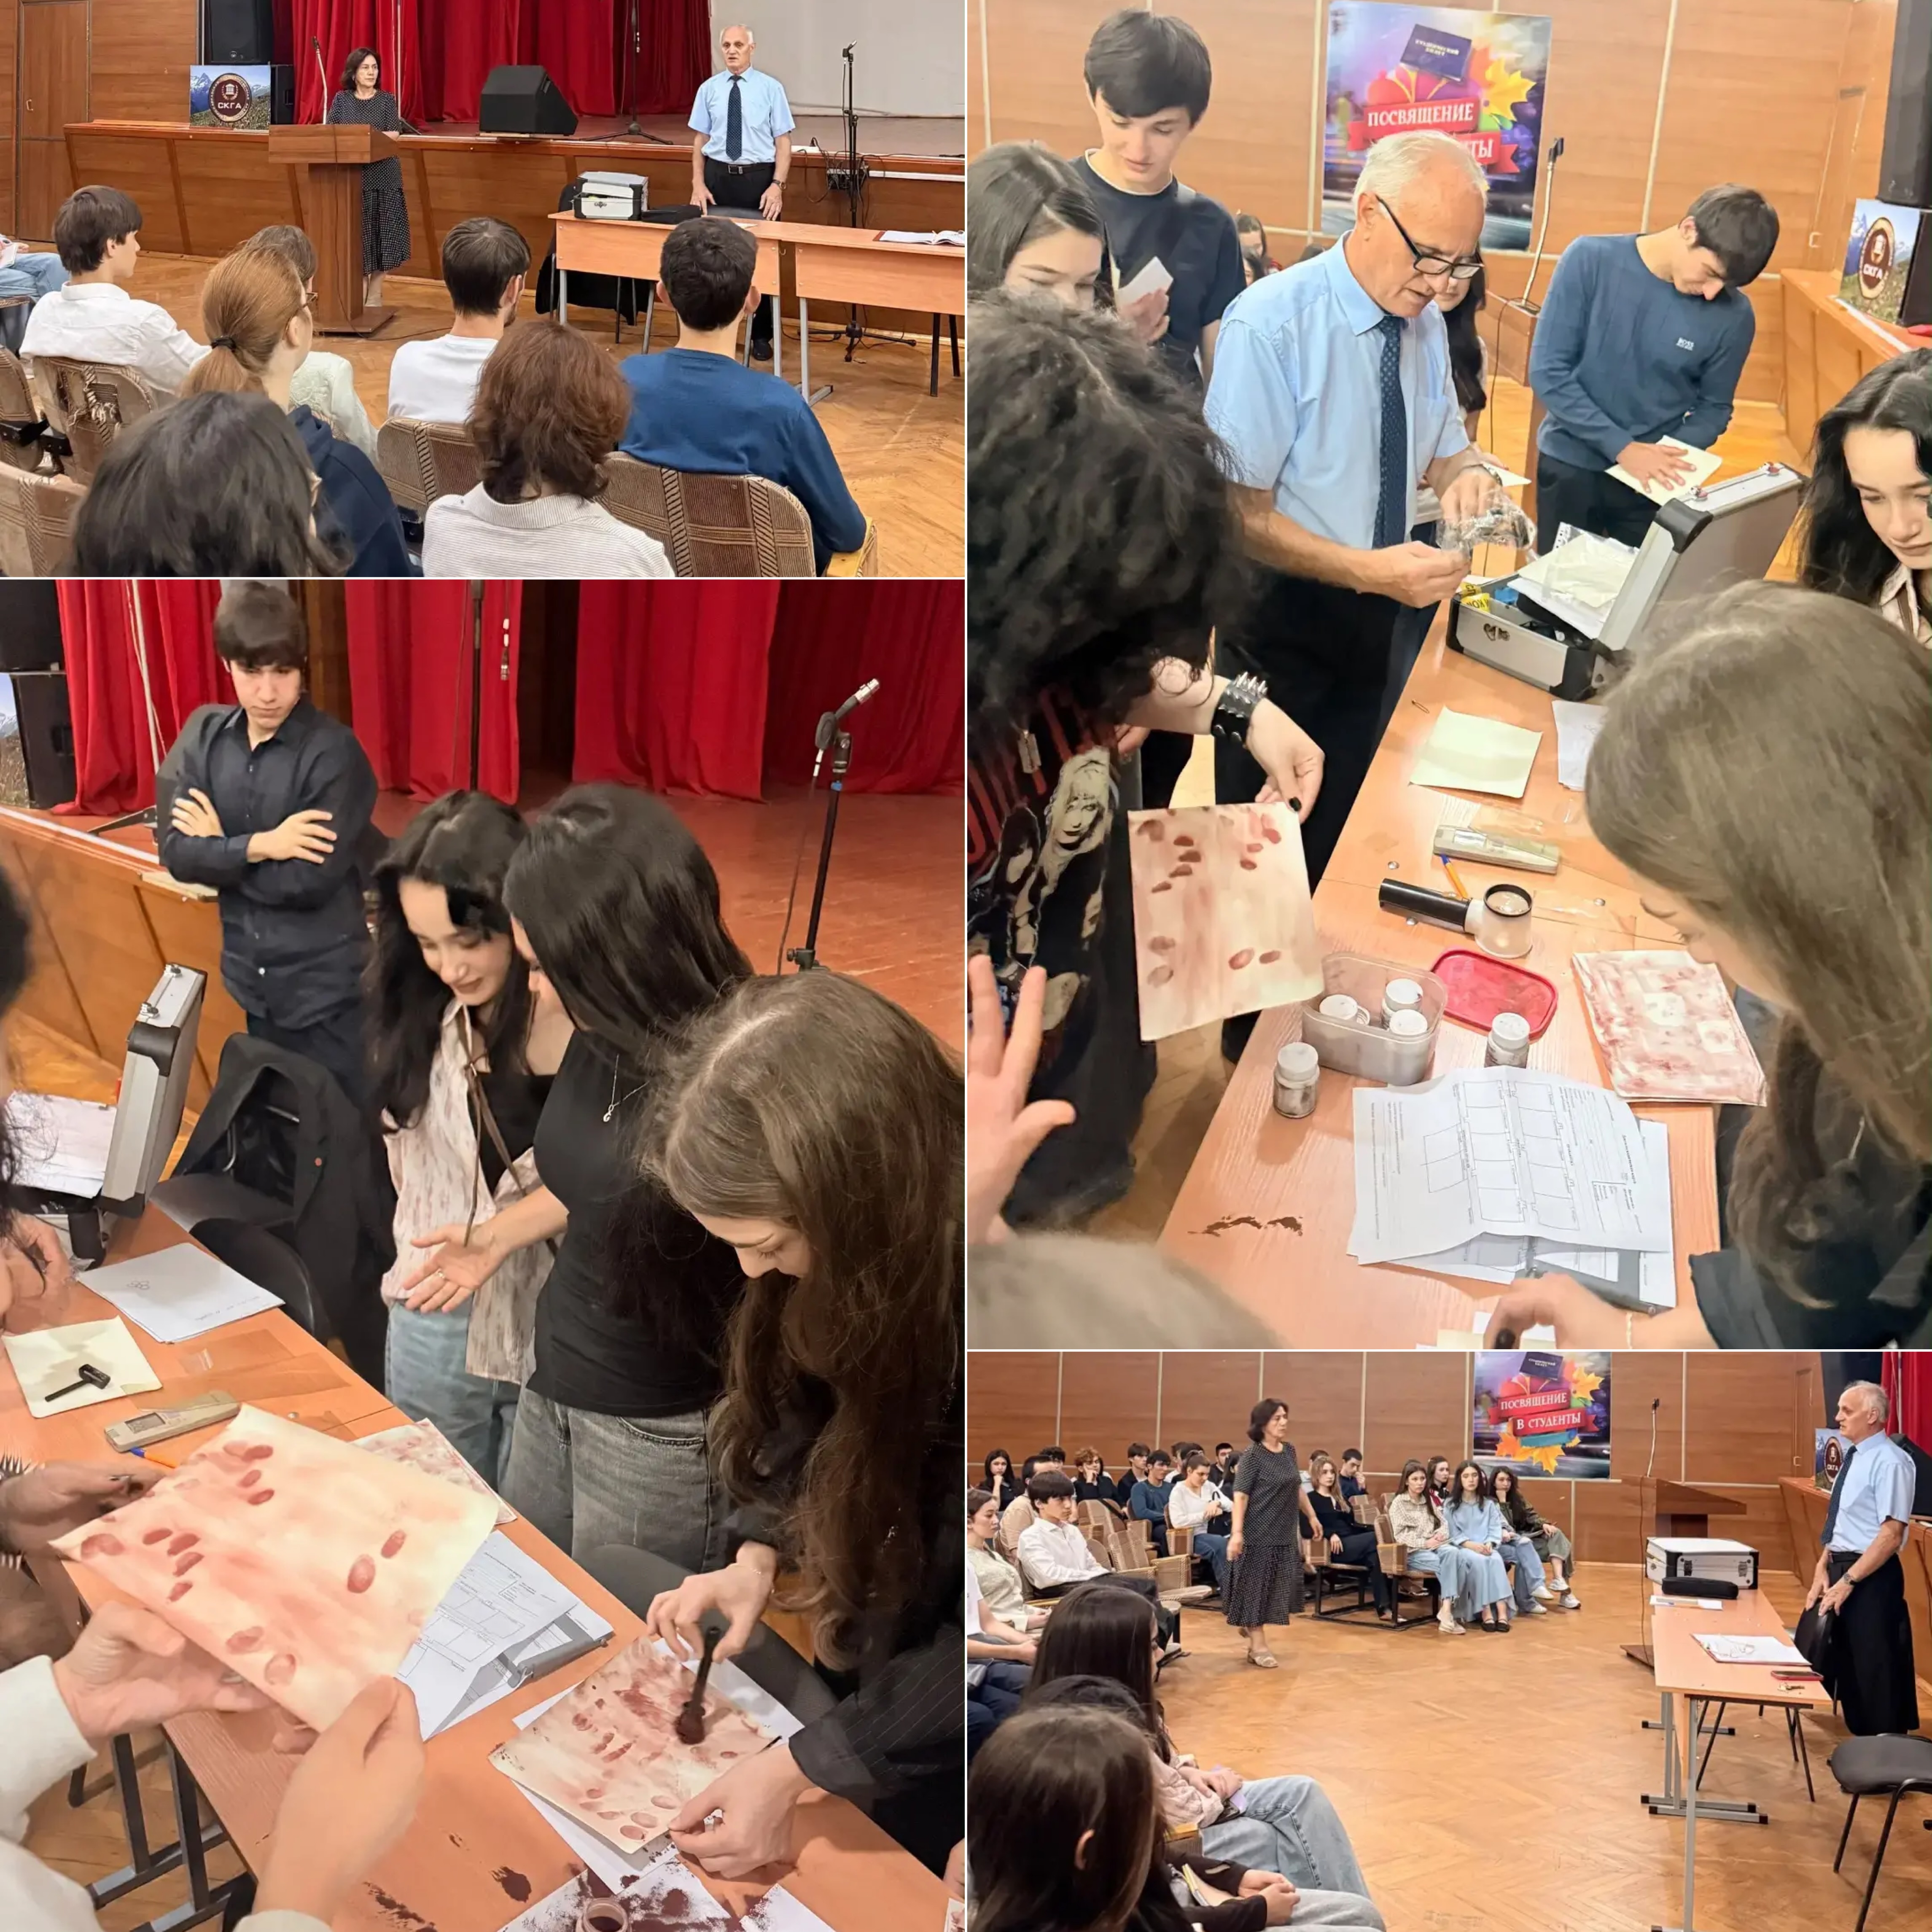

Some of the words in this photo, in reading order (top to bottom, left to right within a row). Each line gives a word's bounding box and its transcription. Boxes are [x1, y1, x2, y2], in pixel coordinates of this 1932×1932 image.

[1368, 103, 1474, 126] ПОСВЯЩЕНИЕ
[1501, 1392, 1567, 1410] ПОСВЯЩЕНИЕ
[1517, 1419, 1524, 1429] В
[1528, 1412, 1581, 1428] СТУДЕНТЫ
